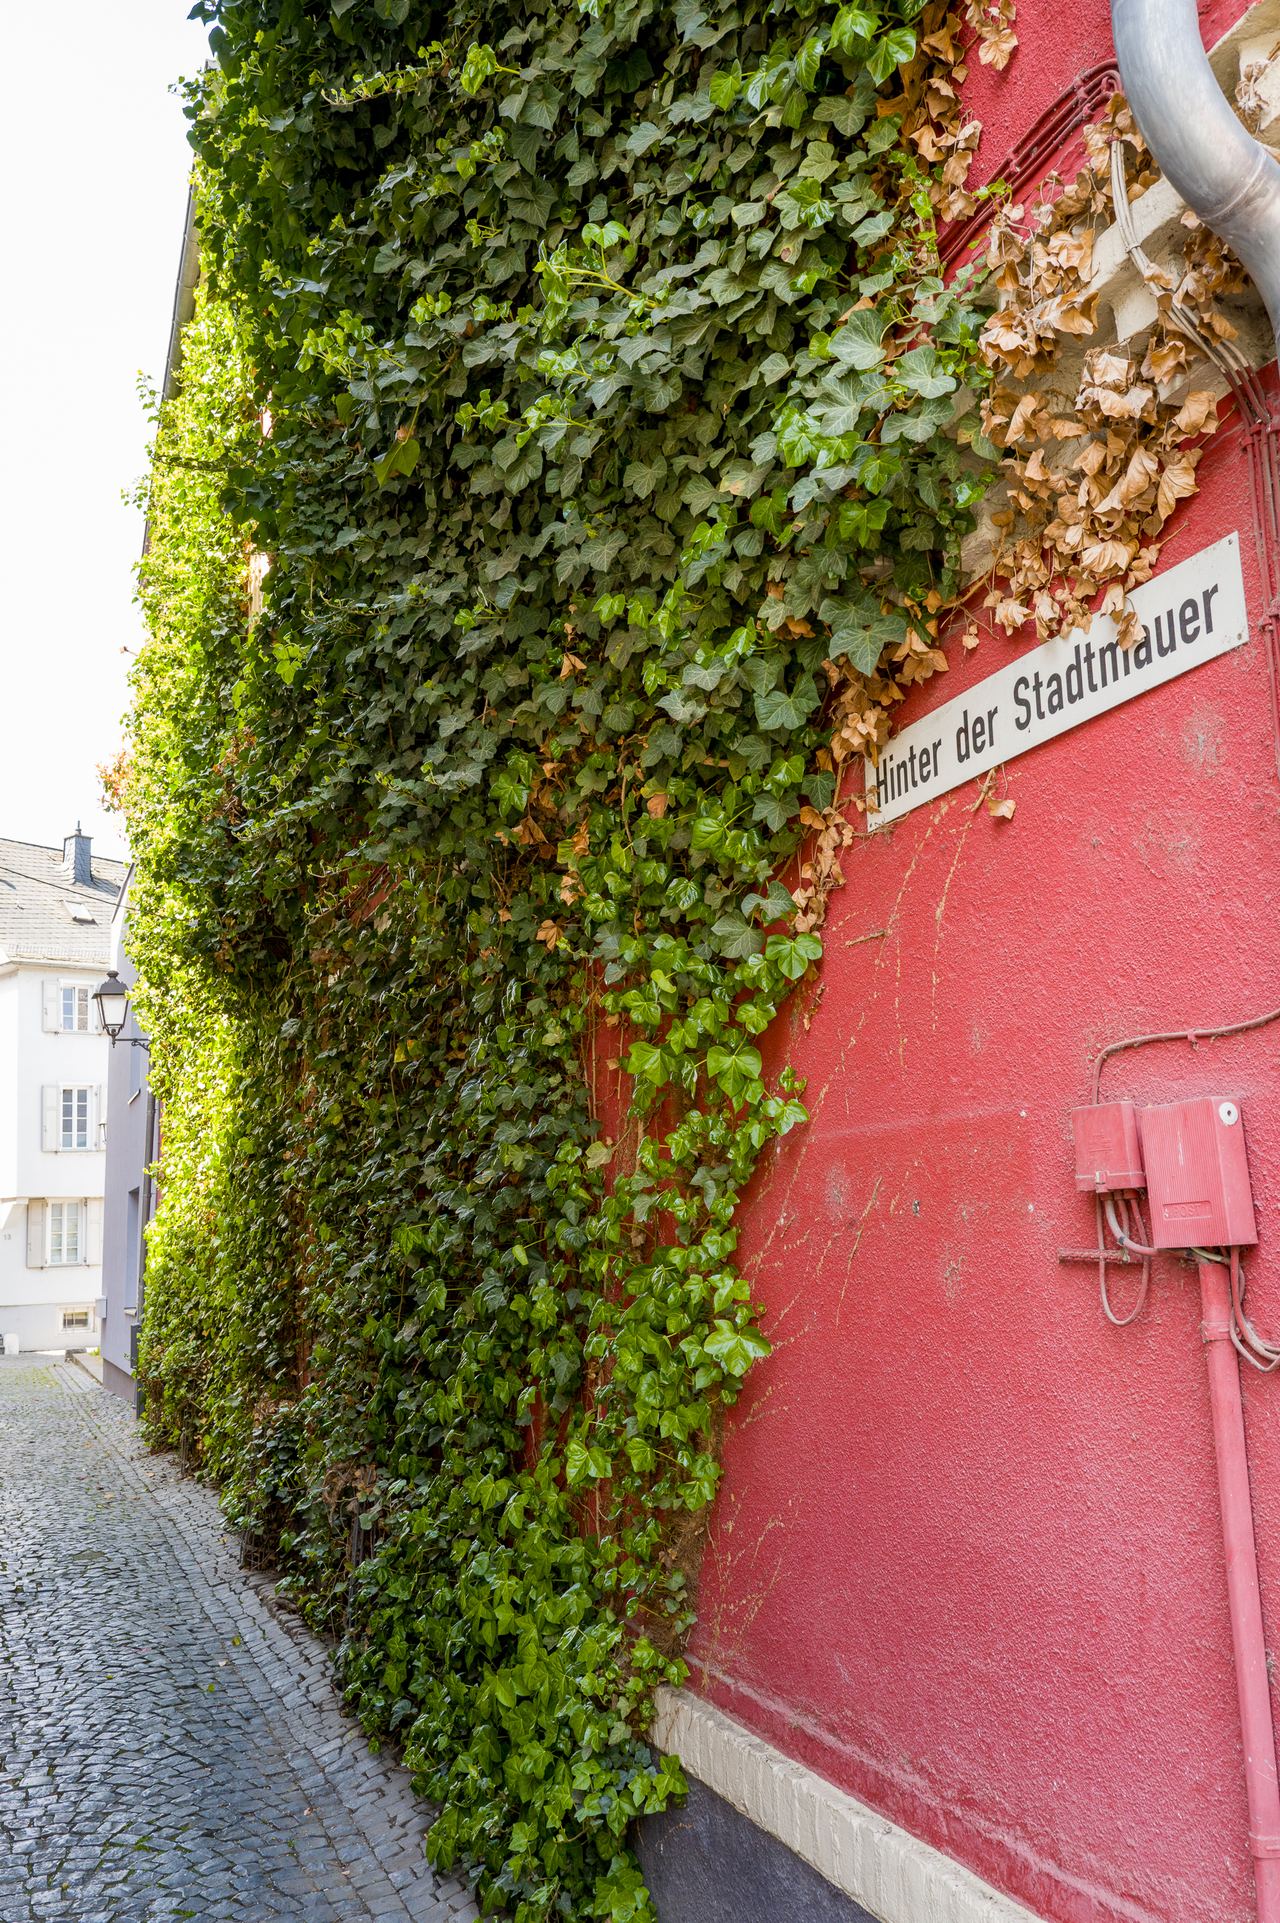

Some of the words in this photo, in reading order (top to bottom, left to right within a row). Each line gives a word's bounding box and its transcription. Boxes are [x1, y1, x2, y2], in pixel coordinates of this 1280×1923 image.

[876, 738, 942, 808] Hinter
[956, 705, 998, 763] der
[1013, 584, 1219, 731] Stadtmauer
